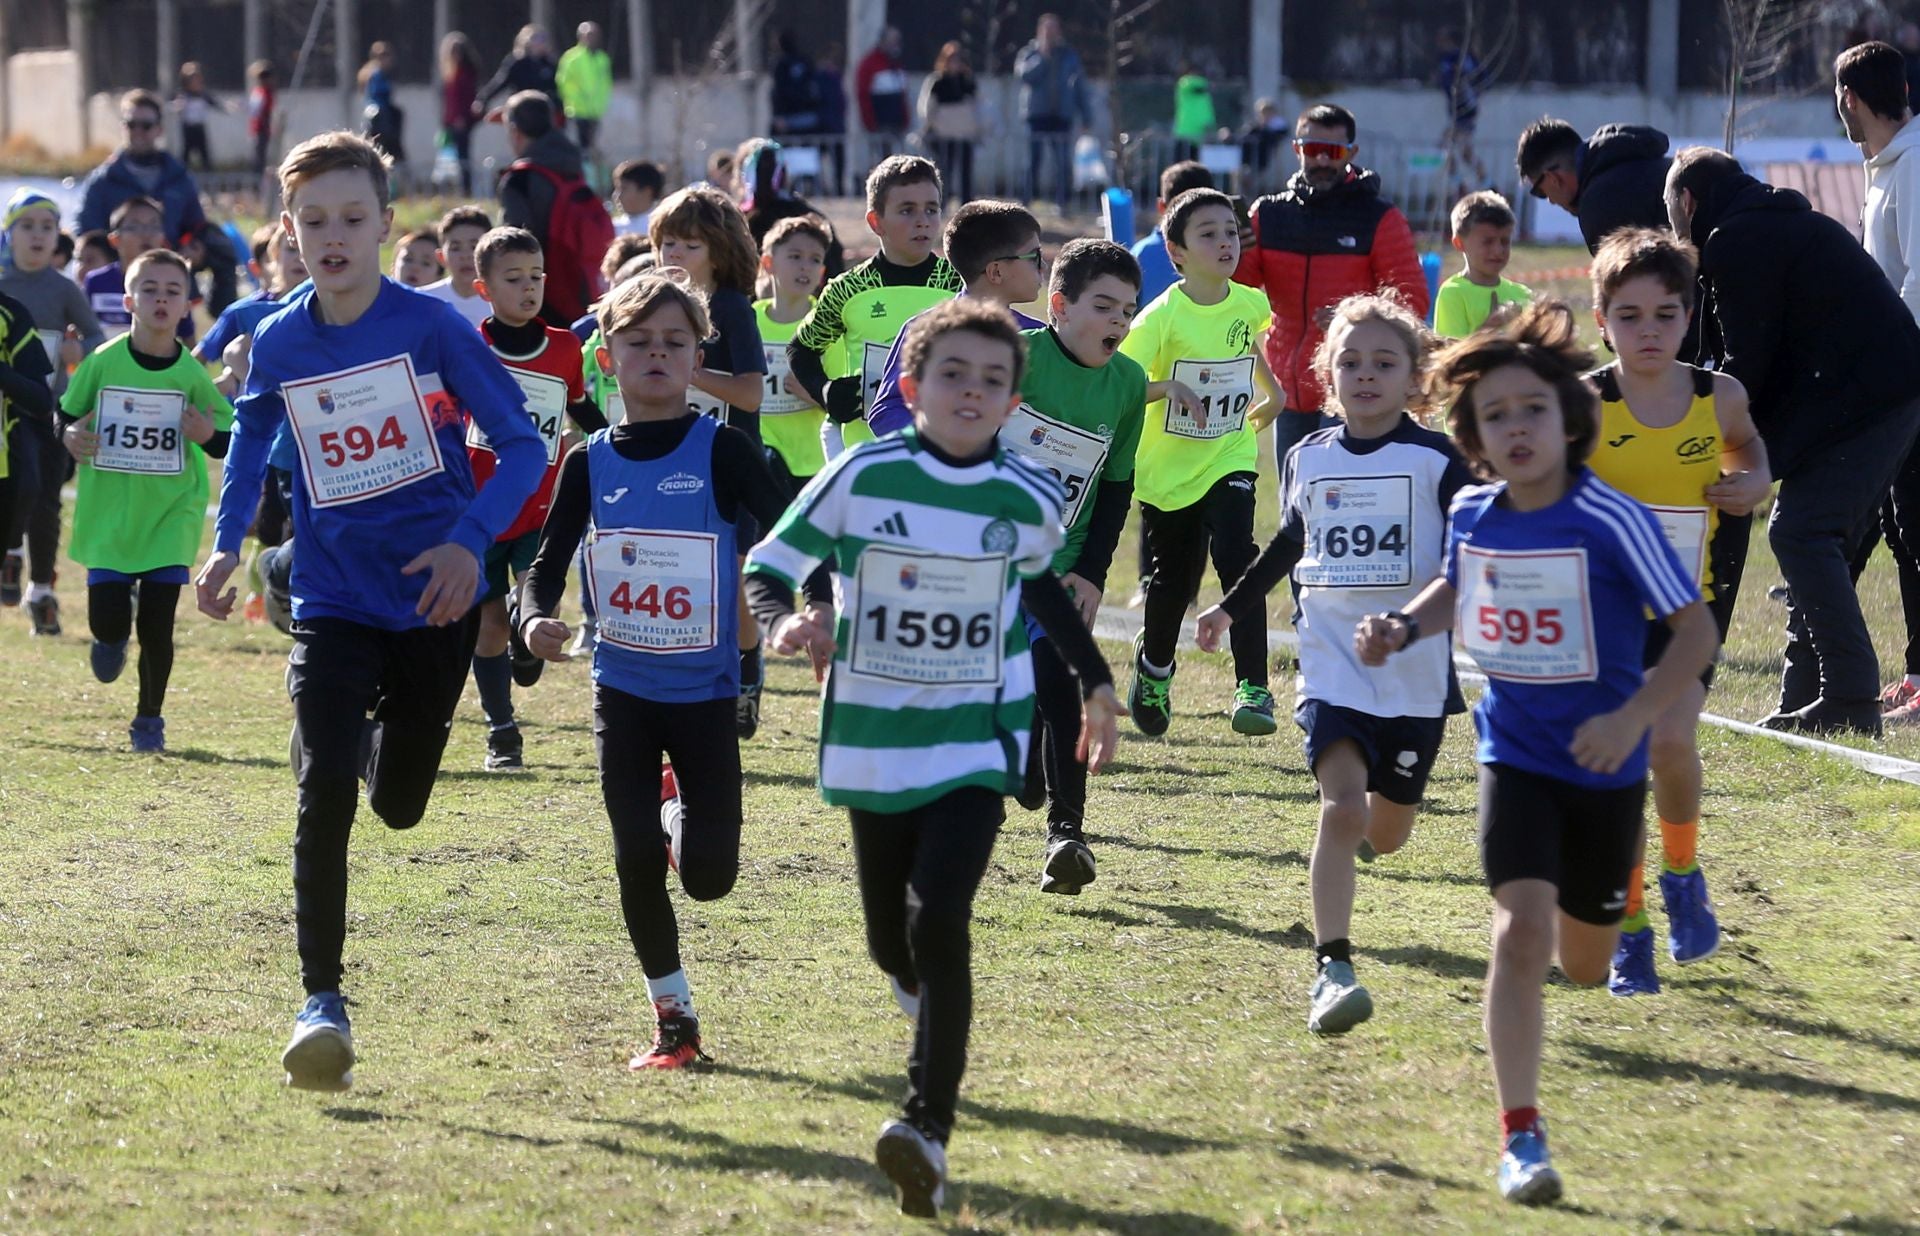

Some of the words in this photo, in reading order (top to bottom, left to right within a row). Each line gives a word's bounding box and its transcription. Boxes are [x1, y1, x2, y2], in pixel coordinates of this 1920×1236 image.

[333, 384, 376, 401] Diputación
[337, 401, 347, 410] de
[349, 394, 378, 409] Segovia
[103, 423, 177, 451] 1558
[319, 415, 408, 468] 594
[1046, 435, 1078, 450] Diputación
[1052, 446, 1073, 457] Segovia
[335, 471, 361, 484] CROSS
[363, 456, 411, 478] NACIONAL
[412, 450, 424, 460] DE
[326, 475, 394, 497] CANTIMPALOS
[400, 461, 426, 477] 2025
[657, 479, 704, 491] CRONOS
[1312, 524, 1408, 558] 1694
[638, 548, 680, 558] Diputación
[637, 559, 648, 567] de
[650, 560, 679, 568] Segovia
[1345, 564, 1388, 572] NACIONAL
[1376, 574, 1400, 582] 2025
[609, 581, 692, 620] 446
[618, 622, 640, 632] CROSS
[643, 625, 689, 635] NACIONAL
[691, 626, 703, 635] DE
[866, 605, 992, 650] 1596
[1479, 606, 1565, 646] 595
[607, 628, 668, 645] CANTIMPALOS
[675, 637, 701, 645] 2025
